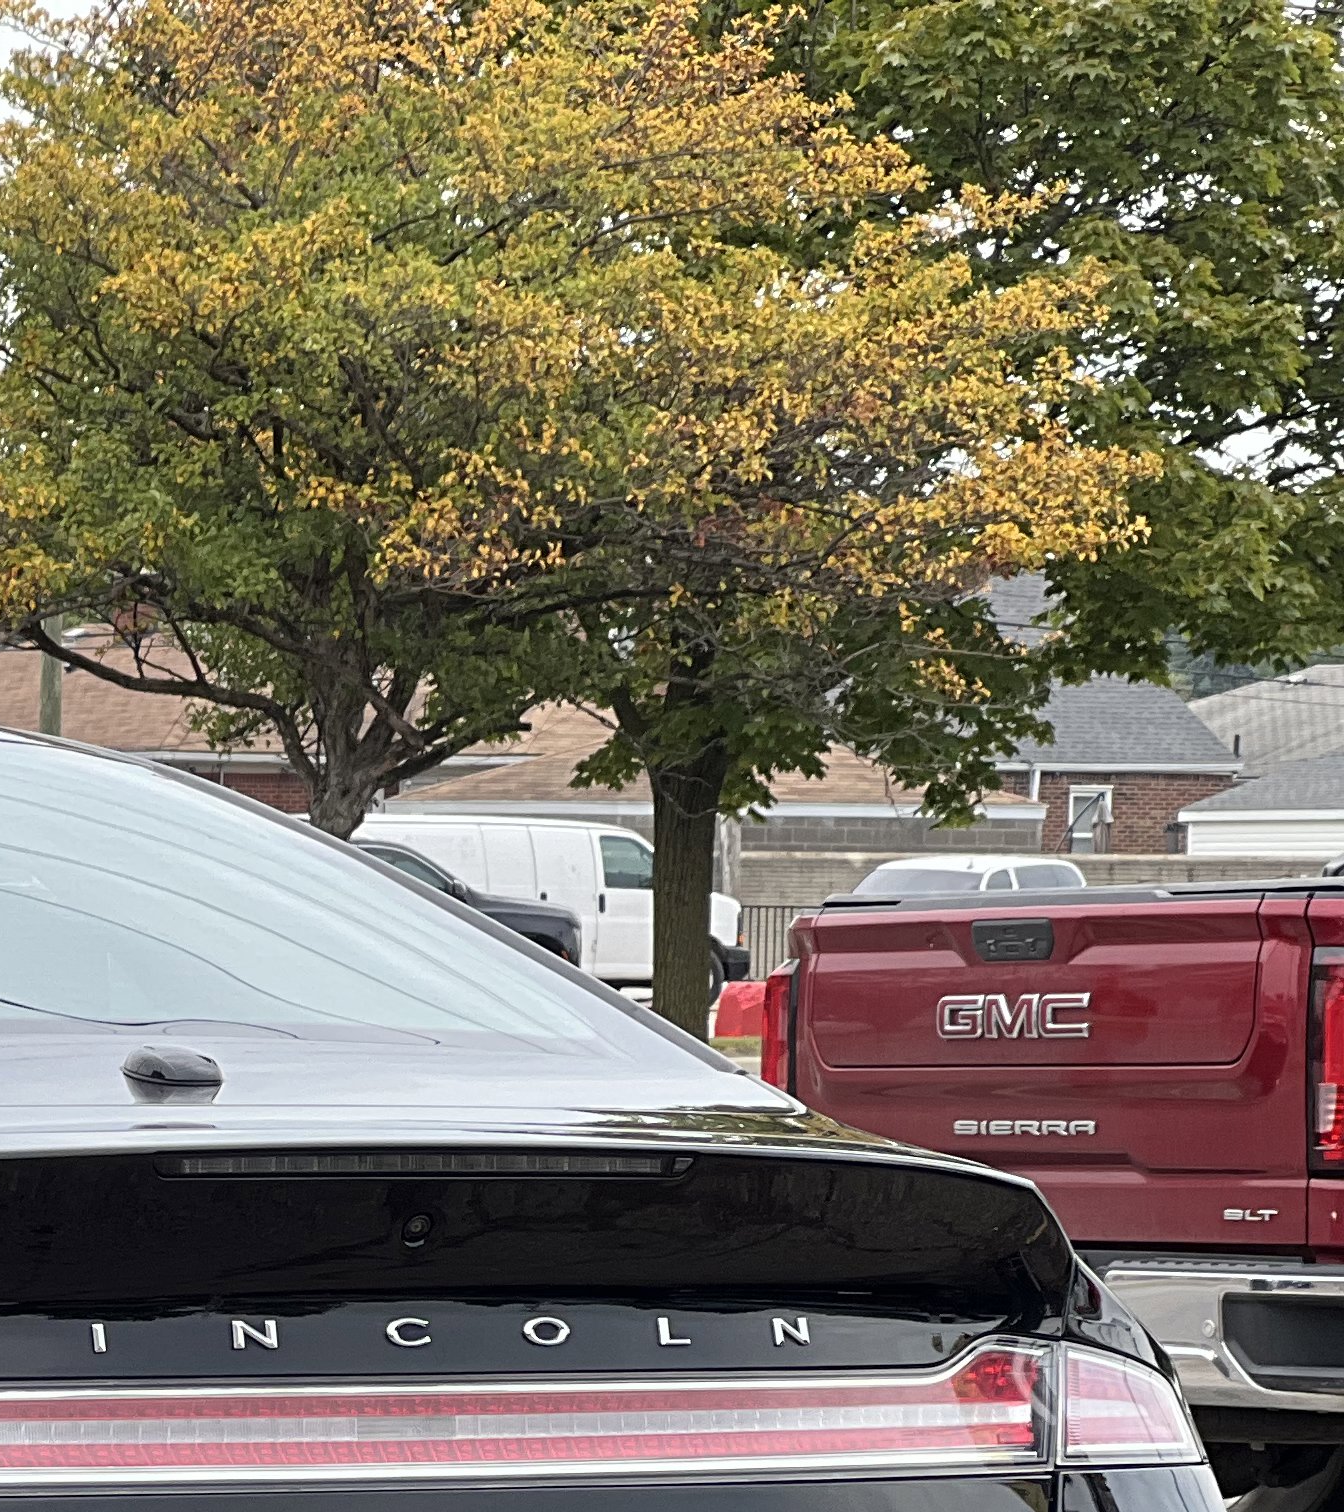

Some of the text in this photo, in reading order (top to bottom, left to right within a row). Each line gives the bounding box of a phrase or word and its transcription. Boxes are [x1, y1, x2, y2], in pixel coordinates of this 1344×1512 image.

[937, 992, 1091, 1039] GMC
[953, 1120, 1096, 1136] SIERRA
[1223, 1208, 1279, 1222] SLT
